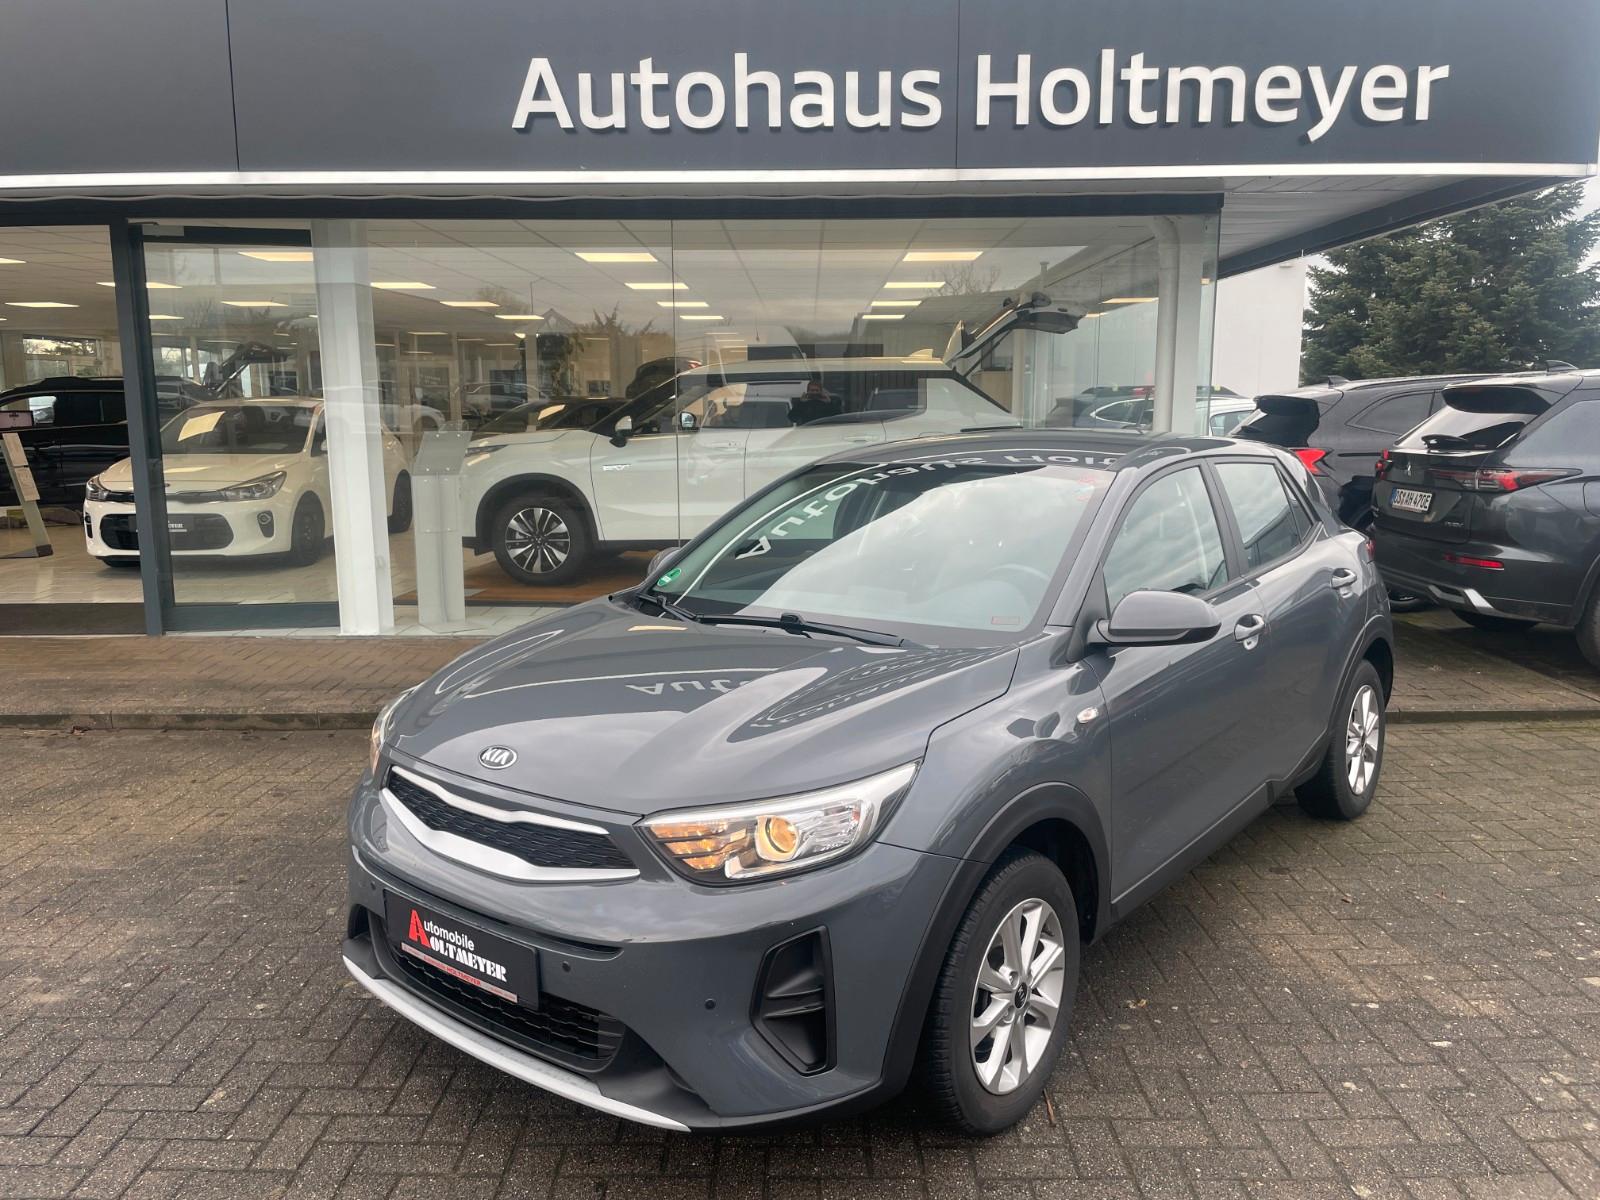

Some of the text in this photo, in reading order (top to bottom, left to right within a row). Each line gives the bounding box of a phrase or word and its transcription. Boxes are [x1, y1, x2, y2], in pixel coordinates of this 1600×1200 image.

[511, 48, 1450, 142] Autohaus Holtmeyer
[480, 747, 511, 766] KIA
[408, 909, 475, 951] Automobile
